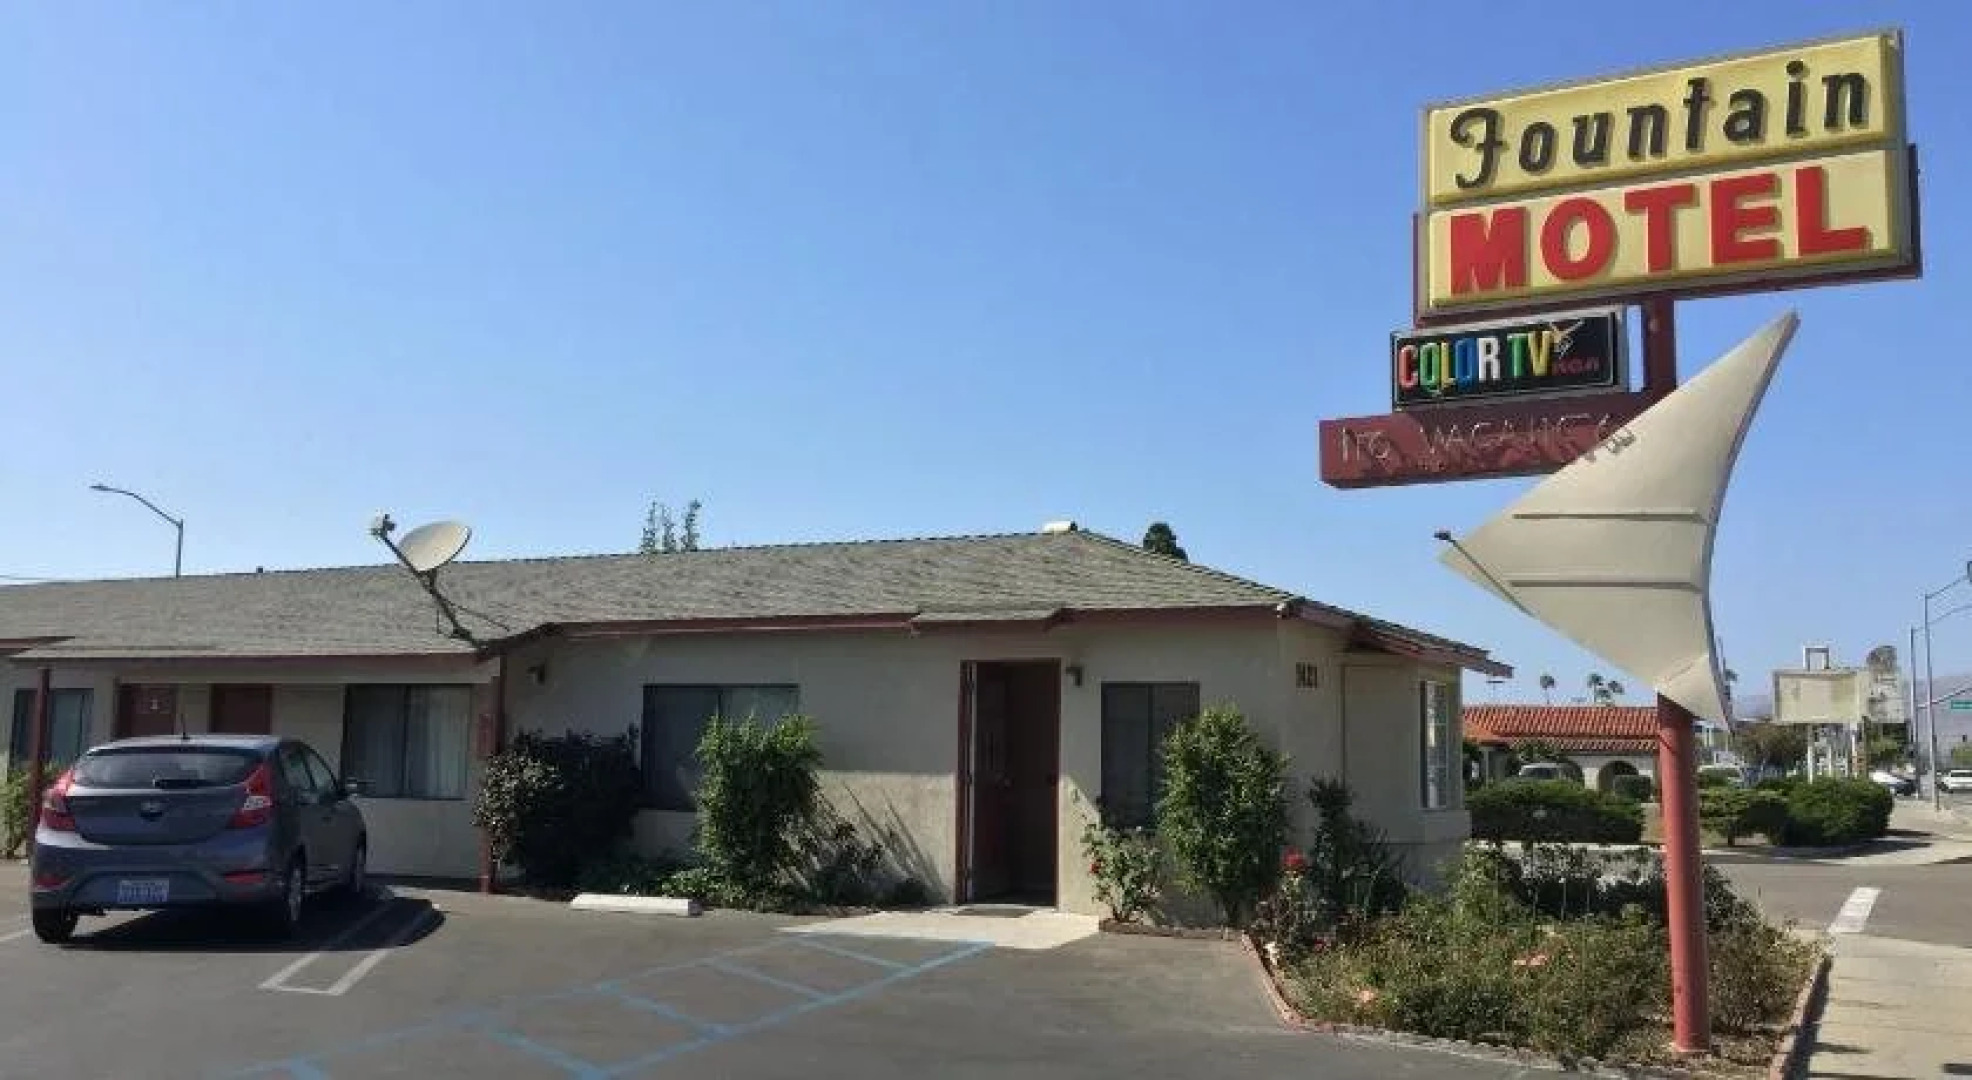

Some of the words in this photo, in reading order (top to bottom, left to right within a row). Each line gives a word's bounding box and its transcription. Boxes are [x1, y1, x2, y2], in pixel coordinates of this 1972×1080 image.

[1450, 60, 1867, 189] Fountain
[1450, 165, 1869, 297] MOTEL
[1400, 336, 1500, 392] COLOR
[1506, 330, 1552, 377] TV
